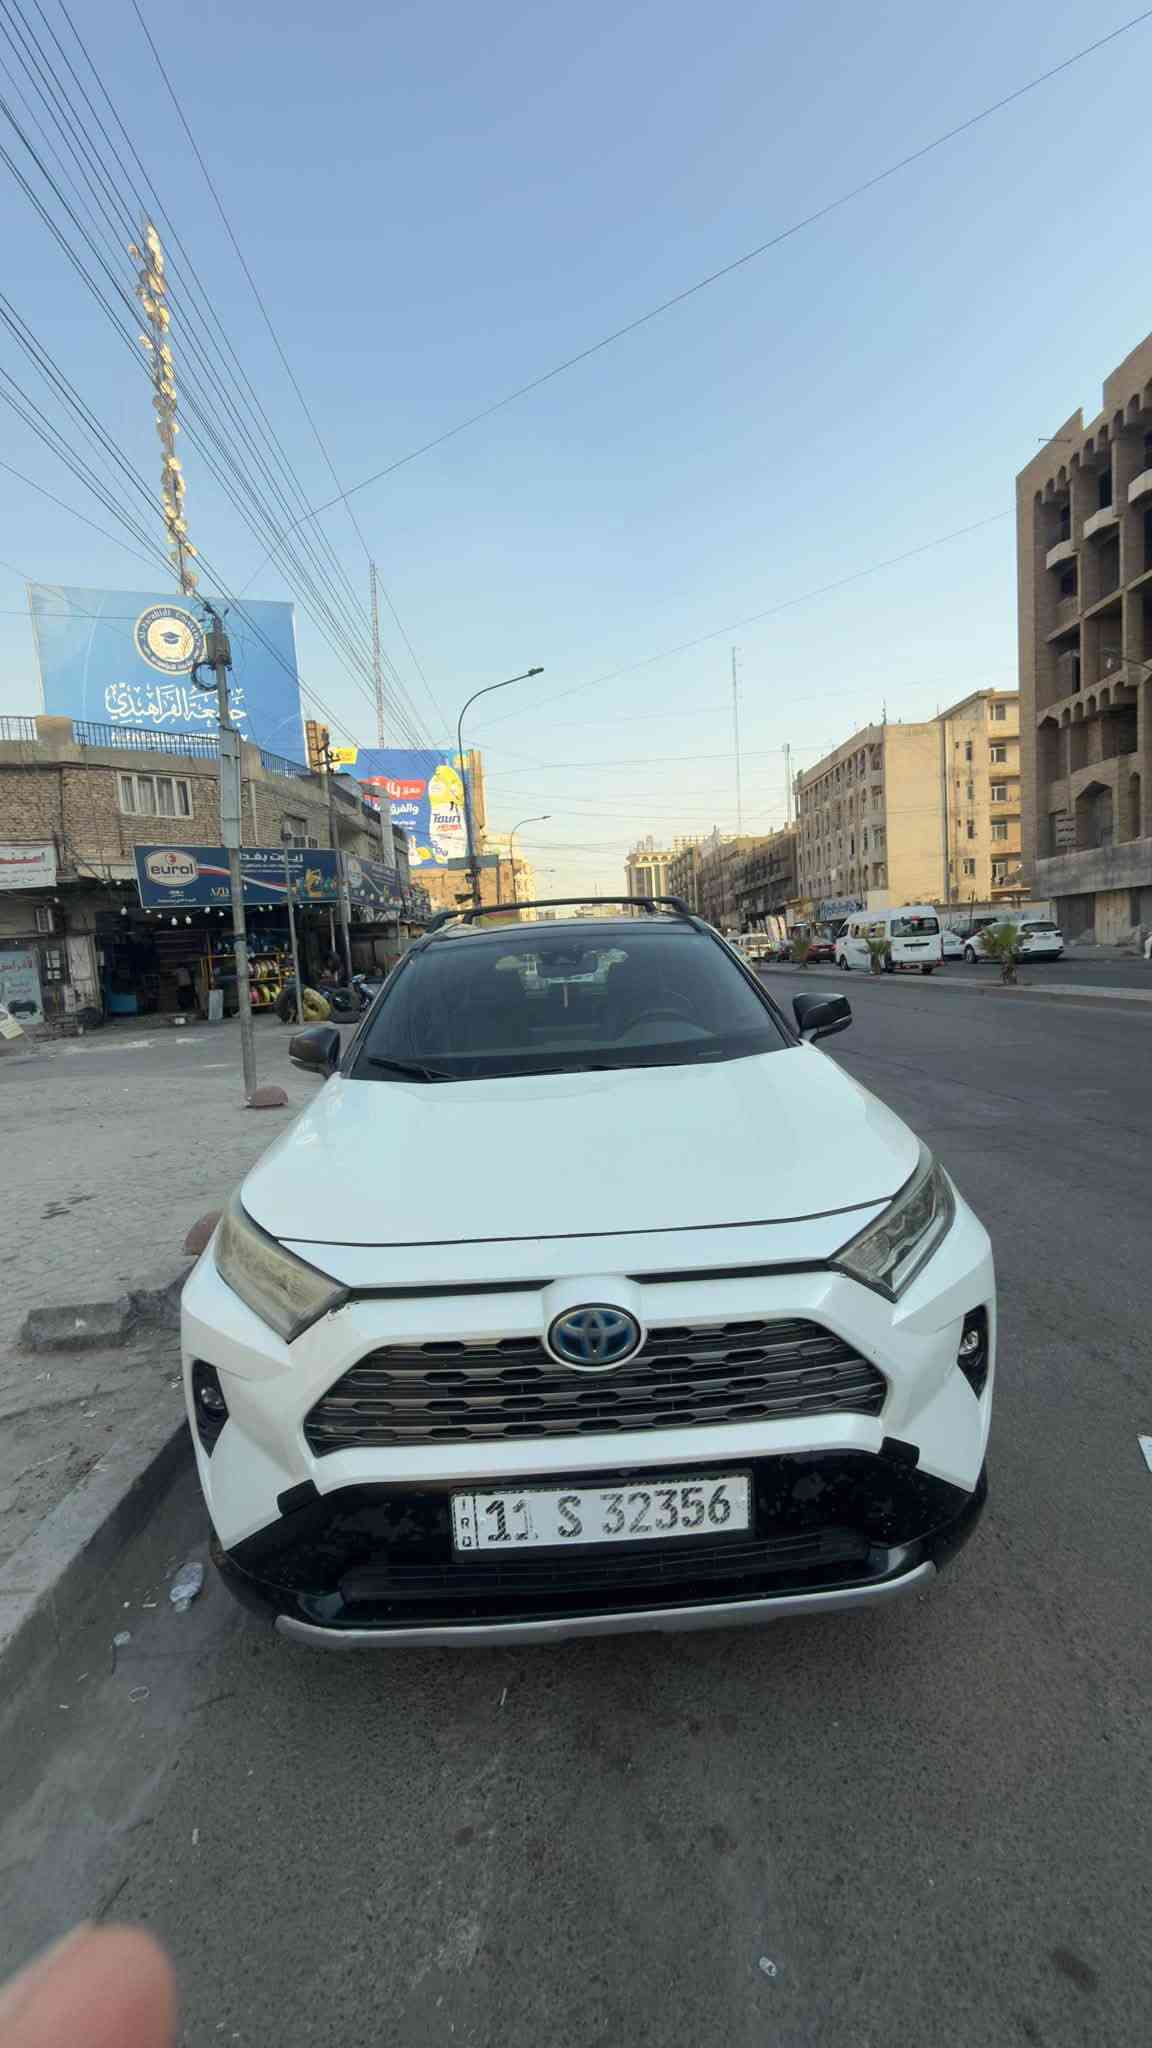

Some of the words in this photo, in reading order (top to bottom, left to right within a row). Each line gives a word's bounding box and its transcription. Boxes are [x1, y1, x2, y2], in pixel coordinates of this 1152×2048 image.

[188, 686, 247, 727] جعة
[151, 863, 193, 875] eurol
[558, 1496, 583, 1537] S
[600, 1485, 731, 1535] 32356
